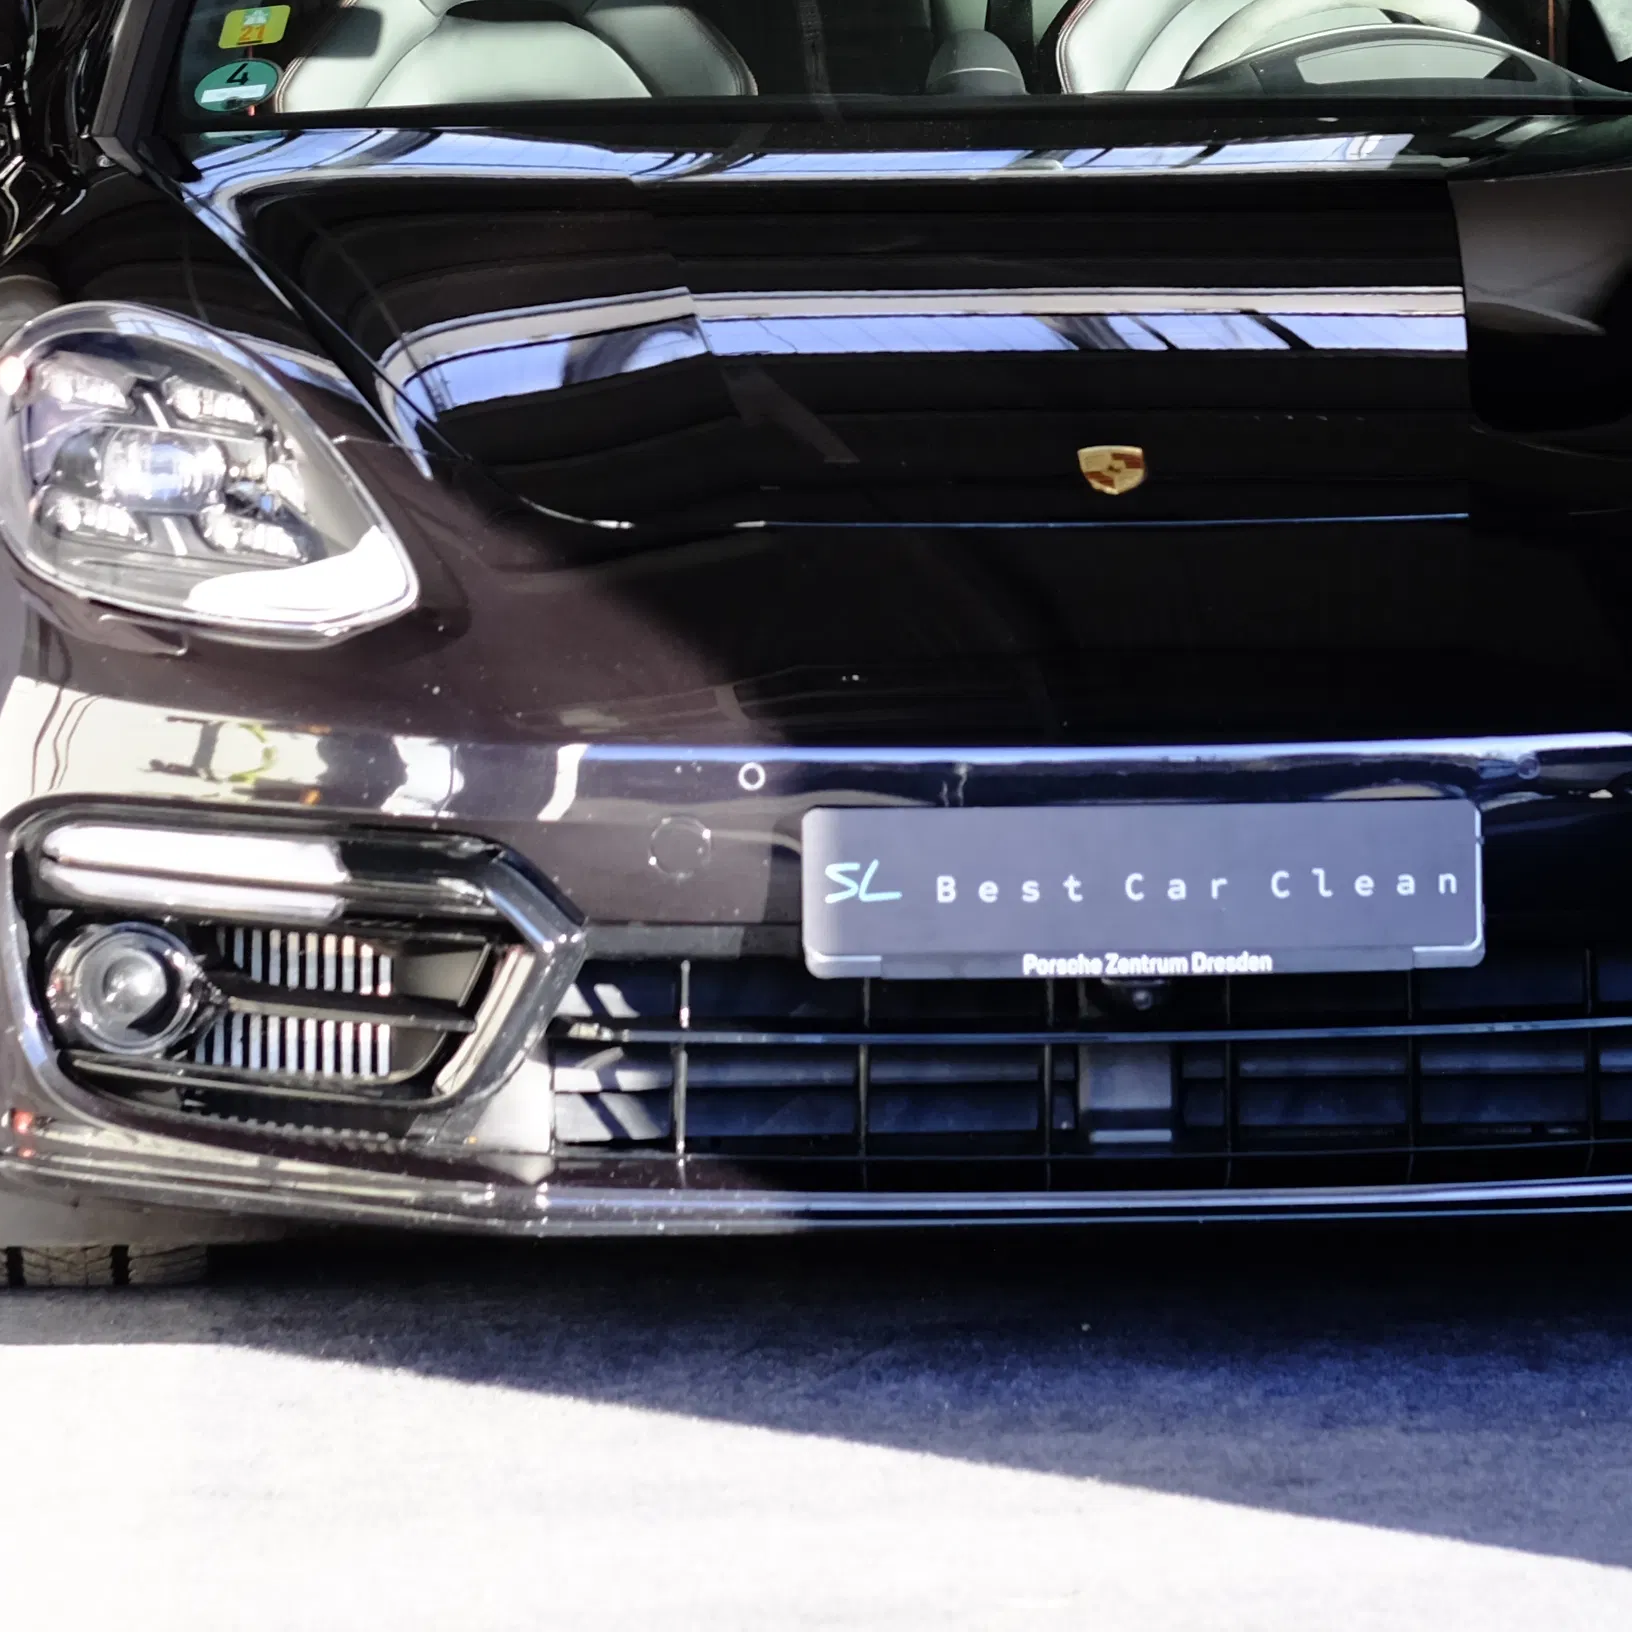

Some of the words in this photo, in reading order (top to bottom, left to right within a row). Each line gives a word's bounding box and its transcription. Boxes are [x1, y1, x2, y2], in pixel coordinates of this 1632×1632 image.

[226, 63, 249, 85] 4
[825, 859, 903, 903] SL
[936, 873, 1084, 903] Best
[1125, 872, 1228, 902] Car
[1271, 868, 1458, 899] Clean
[1023, 953, 1103, 975] Porsche
[1105, 950, 1189, 975] Zentrum
[1191, 947, 1272, 974] Dresden
